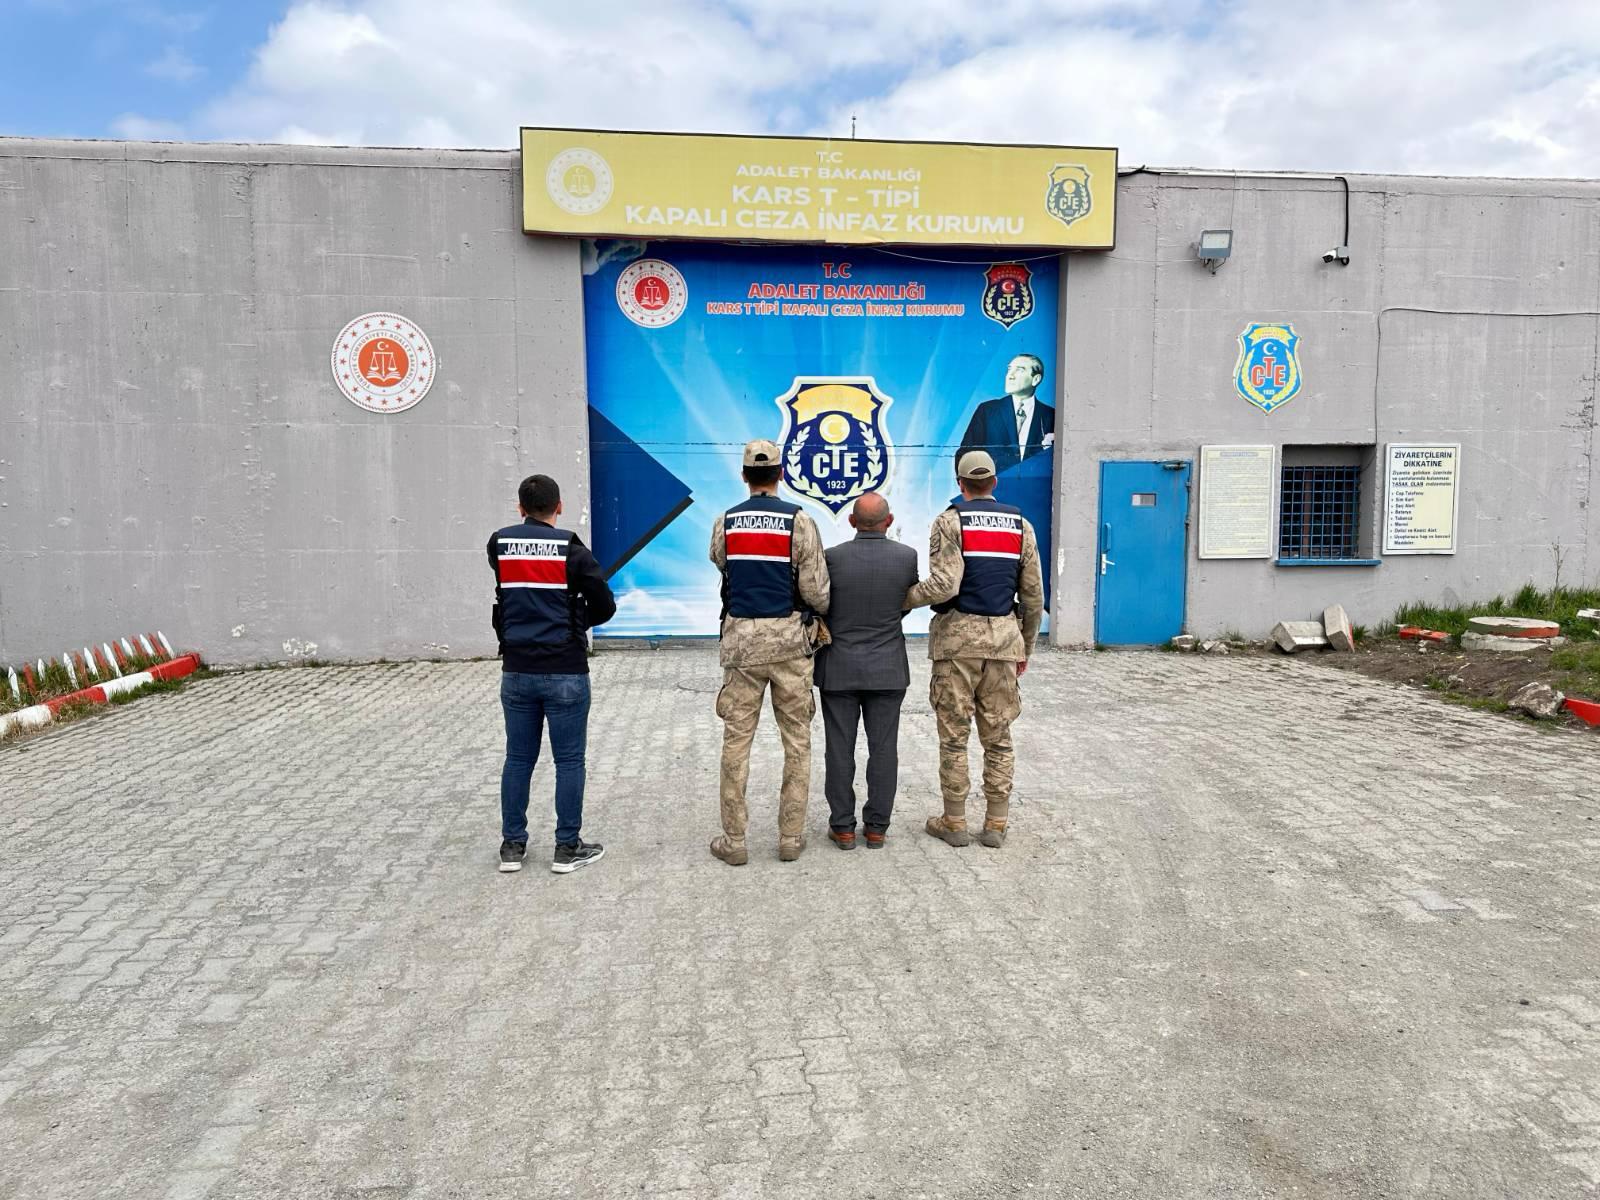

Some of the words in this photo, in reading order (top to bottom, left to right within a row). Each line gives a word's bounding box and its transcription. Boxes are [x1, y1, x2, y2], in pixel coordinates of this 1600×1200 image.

[736, 164, 812, 178] ADALET
[817, 166, 921, 182] BAKANLIĞI
[732, 185, 812, 206] KARS
[819, 187, 838, 207] T
[865, 185, 920, 209] TİPİ
[1059, 193, 1080, 210] CTE
[625, 205, 728, 227] KAPALI
[735, 209, 810, 230] CEZA
[818, 208, 899, 233] İNFAZ
[906, 214, 1025, 235] KURUMU
[822, 262, 852, 279] T.C
[747, 282, 820, 300] ADALET
[823, 281, 926, 301] BAKANLIĞI
[706, 302, 742, 315] KARS
[752, 300, 779, 316] TİPİ
[782, 302, 829, 317] KAPALI
[831, 303, 863, 317] CEZA
[865, 301, 904, 317] İNFAZ
[906, 303, 965, 317] KURUMU
[997, 293, 1020, 311] CTE
[1251, 356, 1286, 387] CTE
[812, 444, 859, 478] CTE
[826, 480, 847, 489] 1923
[731, 515, 786, 530] JANDARMA
[968, 515, 1017, 530] JANDARMA
[504, 543, 560, 556] JANDARMA
